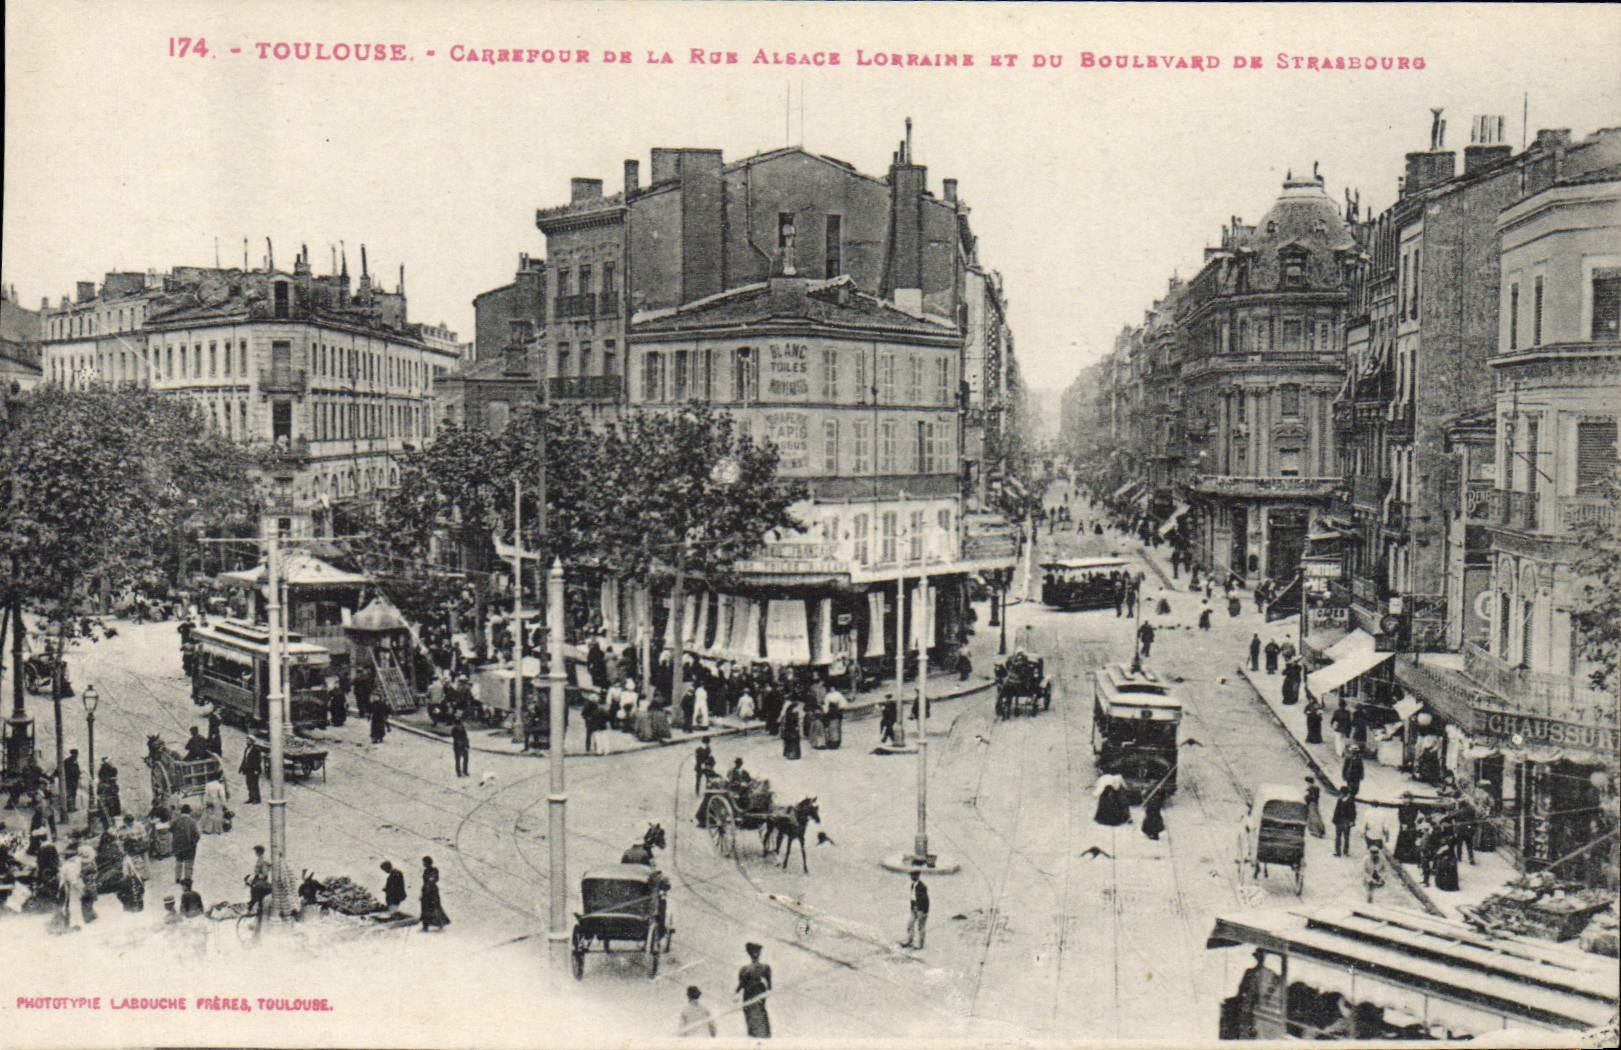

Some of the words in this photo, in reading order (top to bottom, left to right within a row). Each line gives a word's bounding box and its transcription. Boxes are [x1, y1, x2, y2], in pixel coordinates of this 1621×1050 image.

[769, 343, 808, 360] BLANC
[770, 361, 808, 373] TOILES
[1488, 713, 1620, 752] CHAUSSUR
